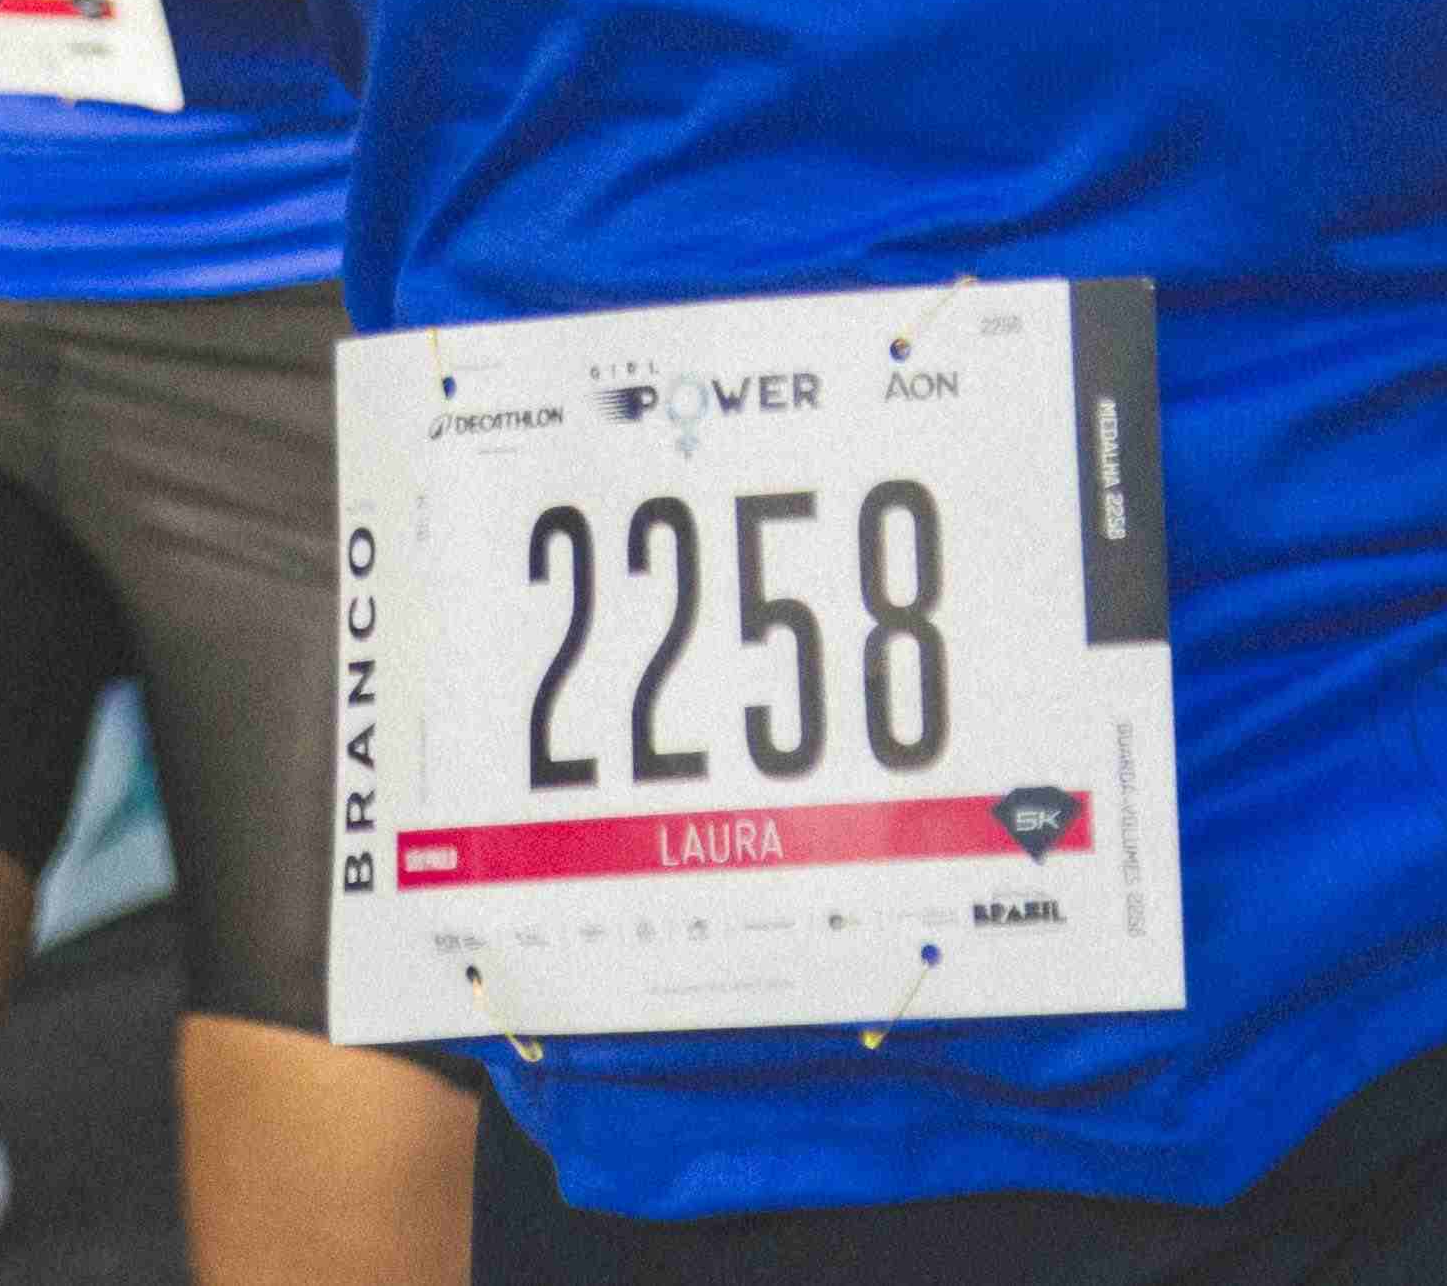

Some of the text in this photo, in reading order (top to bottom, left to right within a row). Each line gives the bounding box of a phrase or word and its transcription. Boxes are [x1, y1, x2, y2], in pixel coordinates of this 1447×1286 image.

[454, 370, 960, 447] DECATHLON POWER AON
[527, 479, 949, 792] 2258
[344, 526, 377, 894] BRANCO
[658, 817, 786, 868] LAURA
[1014, 808, 1061, 833] 5K
